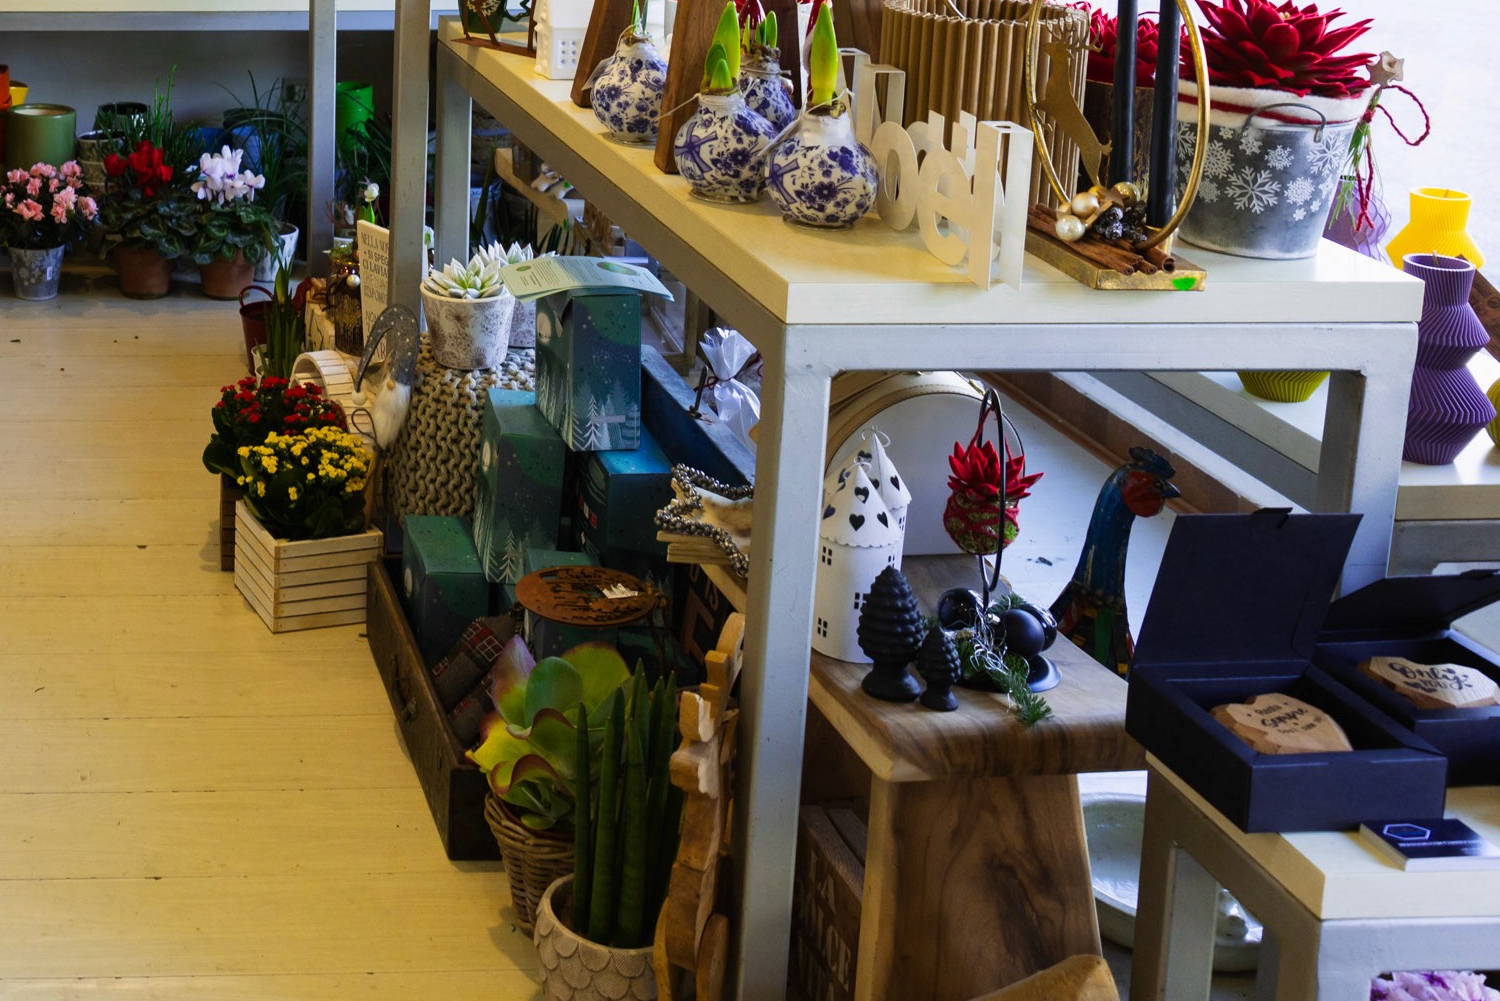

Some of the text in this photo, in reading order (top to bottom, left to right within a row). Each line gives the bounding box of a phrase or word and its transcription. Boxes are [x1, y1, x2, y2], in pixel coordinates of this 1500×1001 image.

[361, 231, 379, 249] NELLA
[368, 250, 374, 259] SI
[1388, 662, 1468, 691] Only
